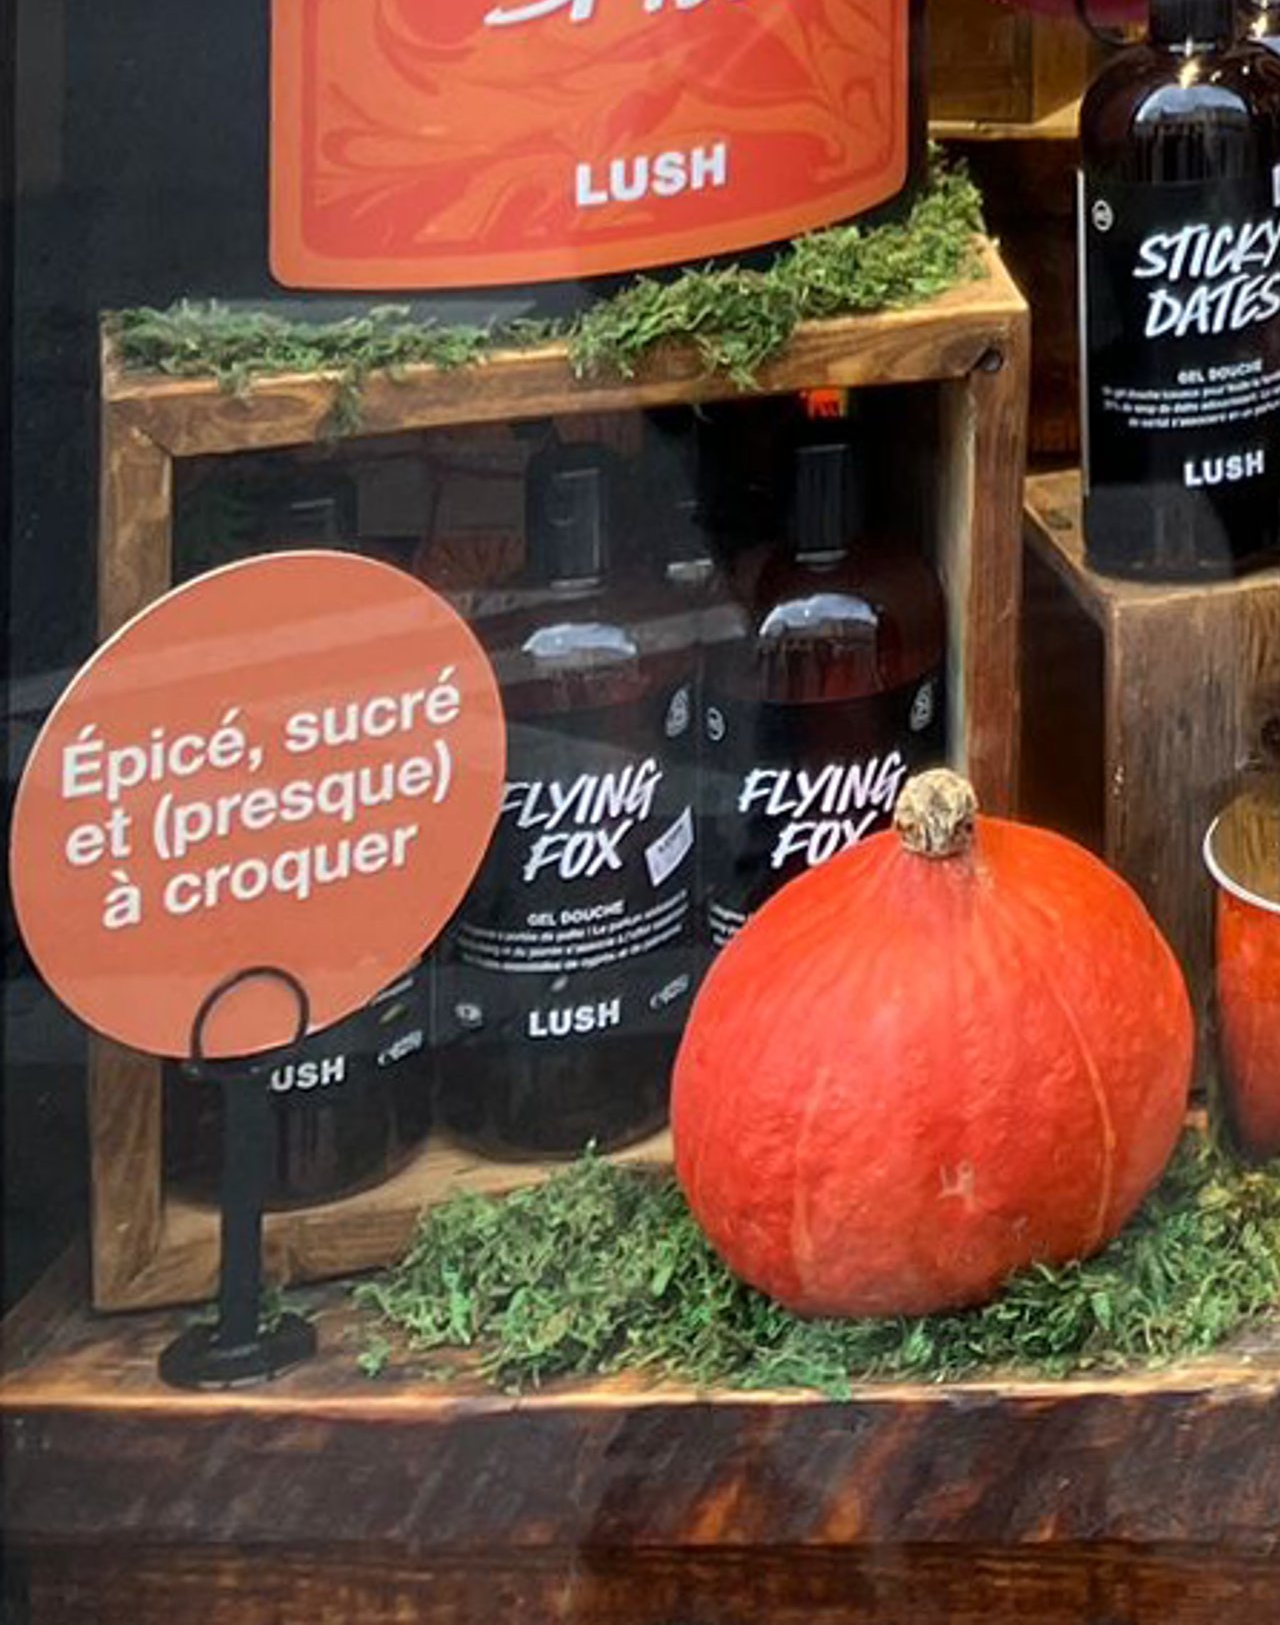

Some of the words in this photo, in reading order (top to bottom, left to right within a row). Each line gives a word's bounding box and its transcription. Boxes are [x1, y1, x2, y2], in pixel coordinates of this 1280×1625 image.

[575, 143, 727, 207] LUSH
[1177, 369, 1205, 385] GEL
[1184, 449, 1265, 487] LUSH
[62, 708, 263, 801] Épicé,
[284, 665, 462, 754] sucré
[65, 808, 132, 867] et
[153, 740, 453, 860] (presque)
[501, 757, 664, 830] FLYING
[737, 751, 907, 816] FLYING
[102, 872, 142, 931] à
[164, 822, 419, 915] croquer
[523, 818, 634, 883] FOX
[527, 911, 557, 927] GEL
[561, 899, 625, 925] DOUCHE
[528, 998, 621, 1037] LUSH
